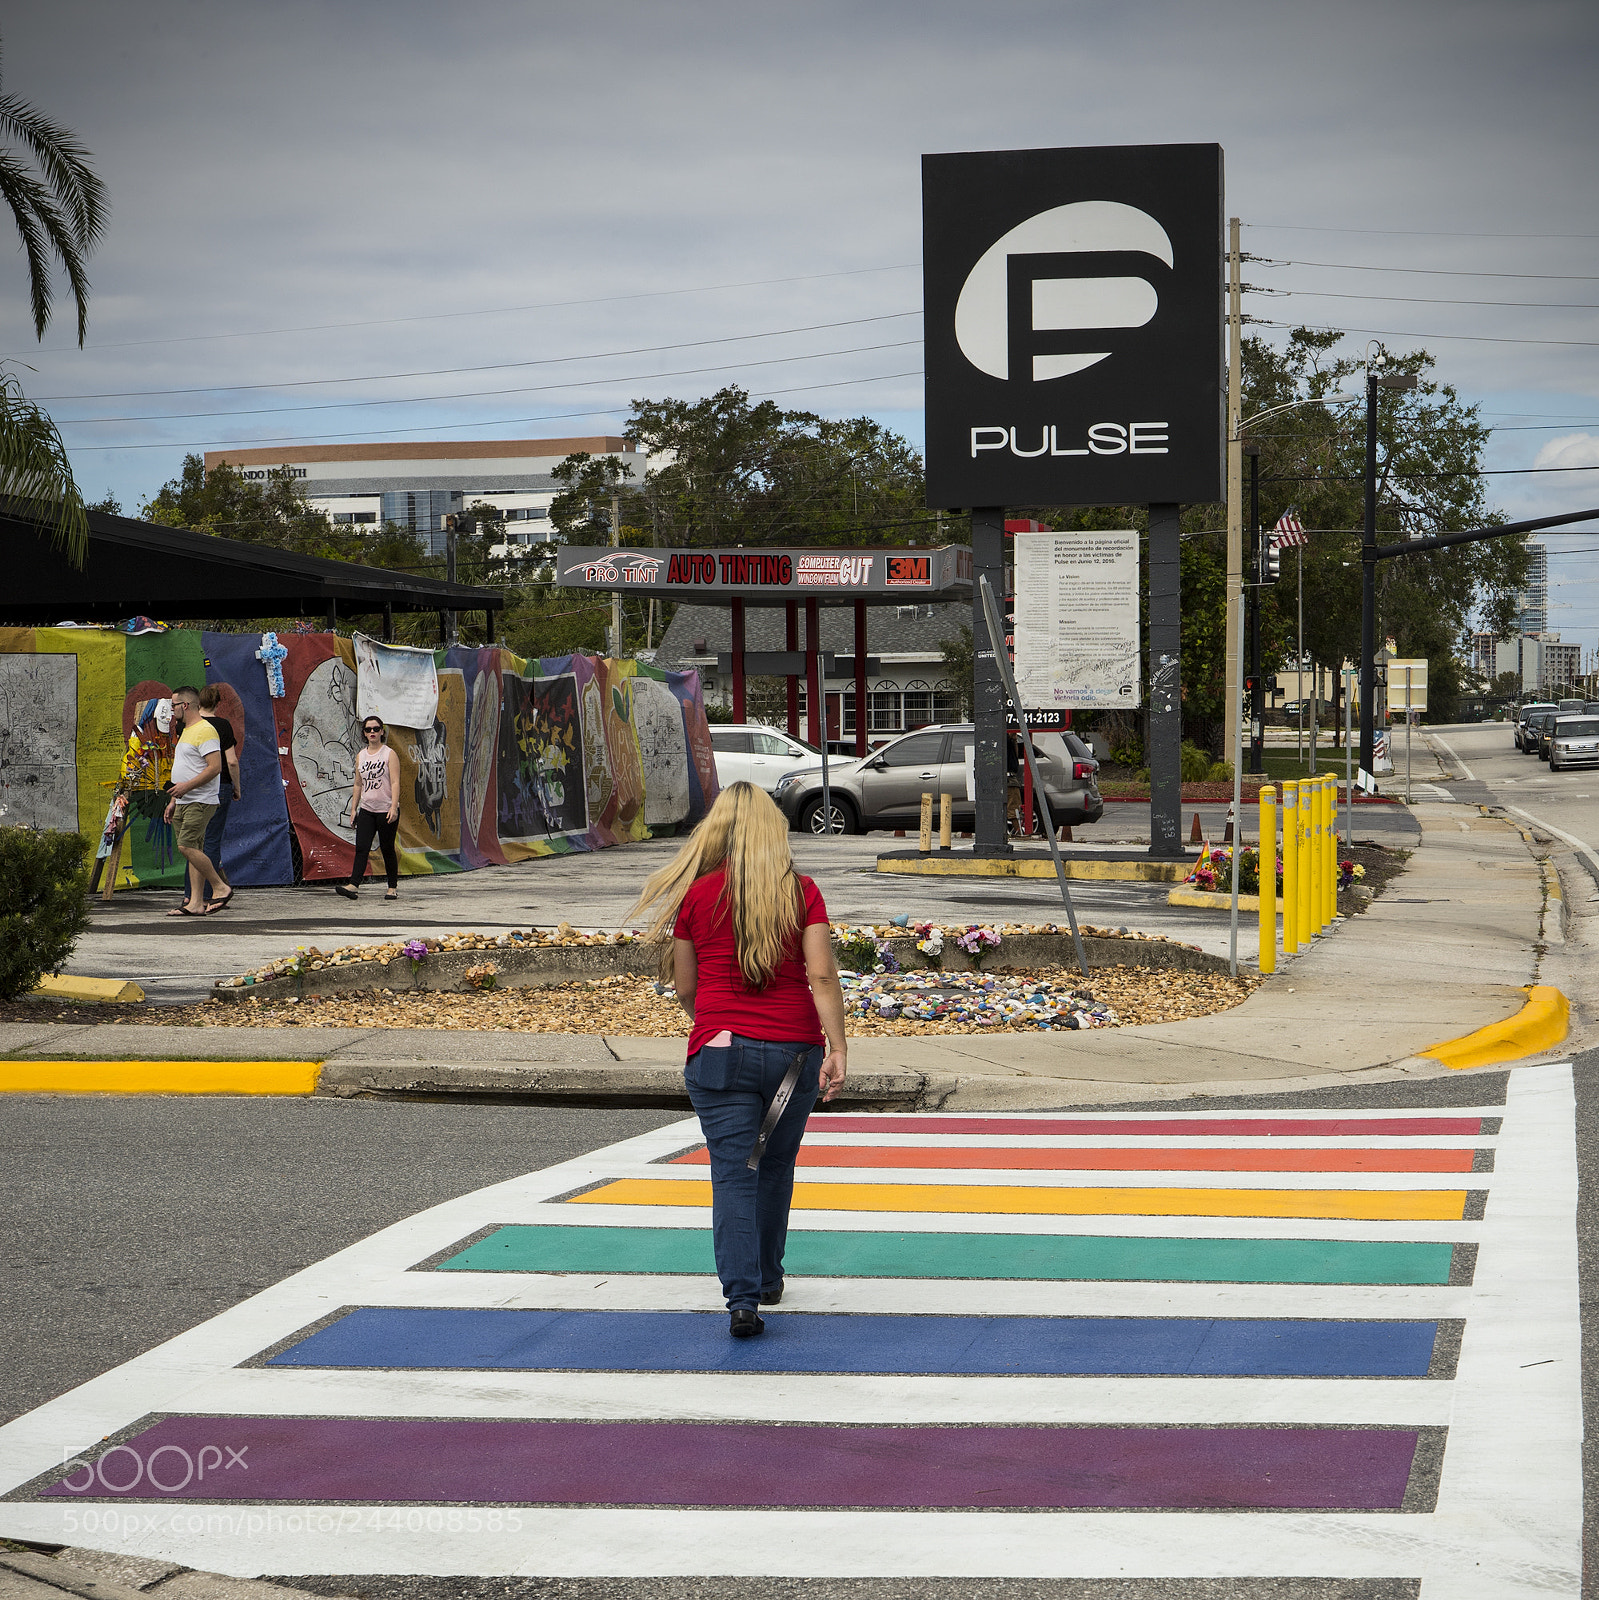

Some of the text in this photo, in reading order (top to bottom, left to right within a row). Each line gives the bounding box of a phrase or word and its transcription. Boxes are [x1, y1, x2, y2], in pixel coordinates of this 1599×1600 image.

[970, 421, 1169, 458] PULSE
[667, 554, 792, 585] AUTO TINTING
[799, 555, 840, 569] COMPUTER
[839, 556, 873, 585] CUT
[890, 558, 928, 579] 3M
[586, 567, 658, 583] PRO TINT
[798, 573, 839, 585] WINDOW FILM
[1005, 712, 1060, 724] 7-41-2123
[408, 743, 451, 764] ORLANDO
[417, 763, 447, 783] UNITED
[362, 778, 383, 793] Vie
